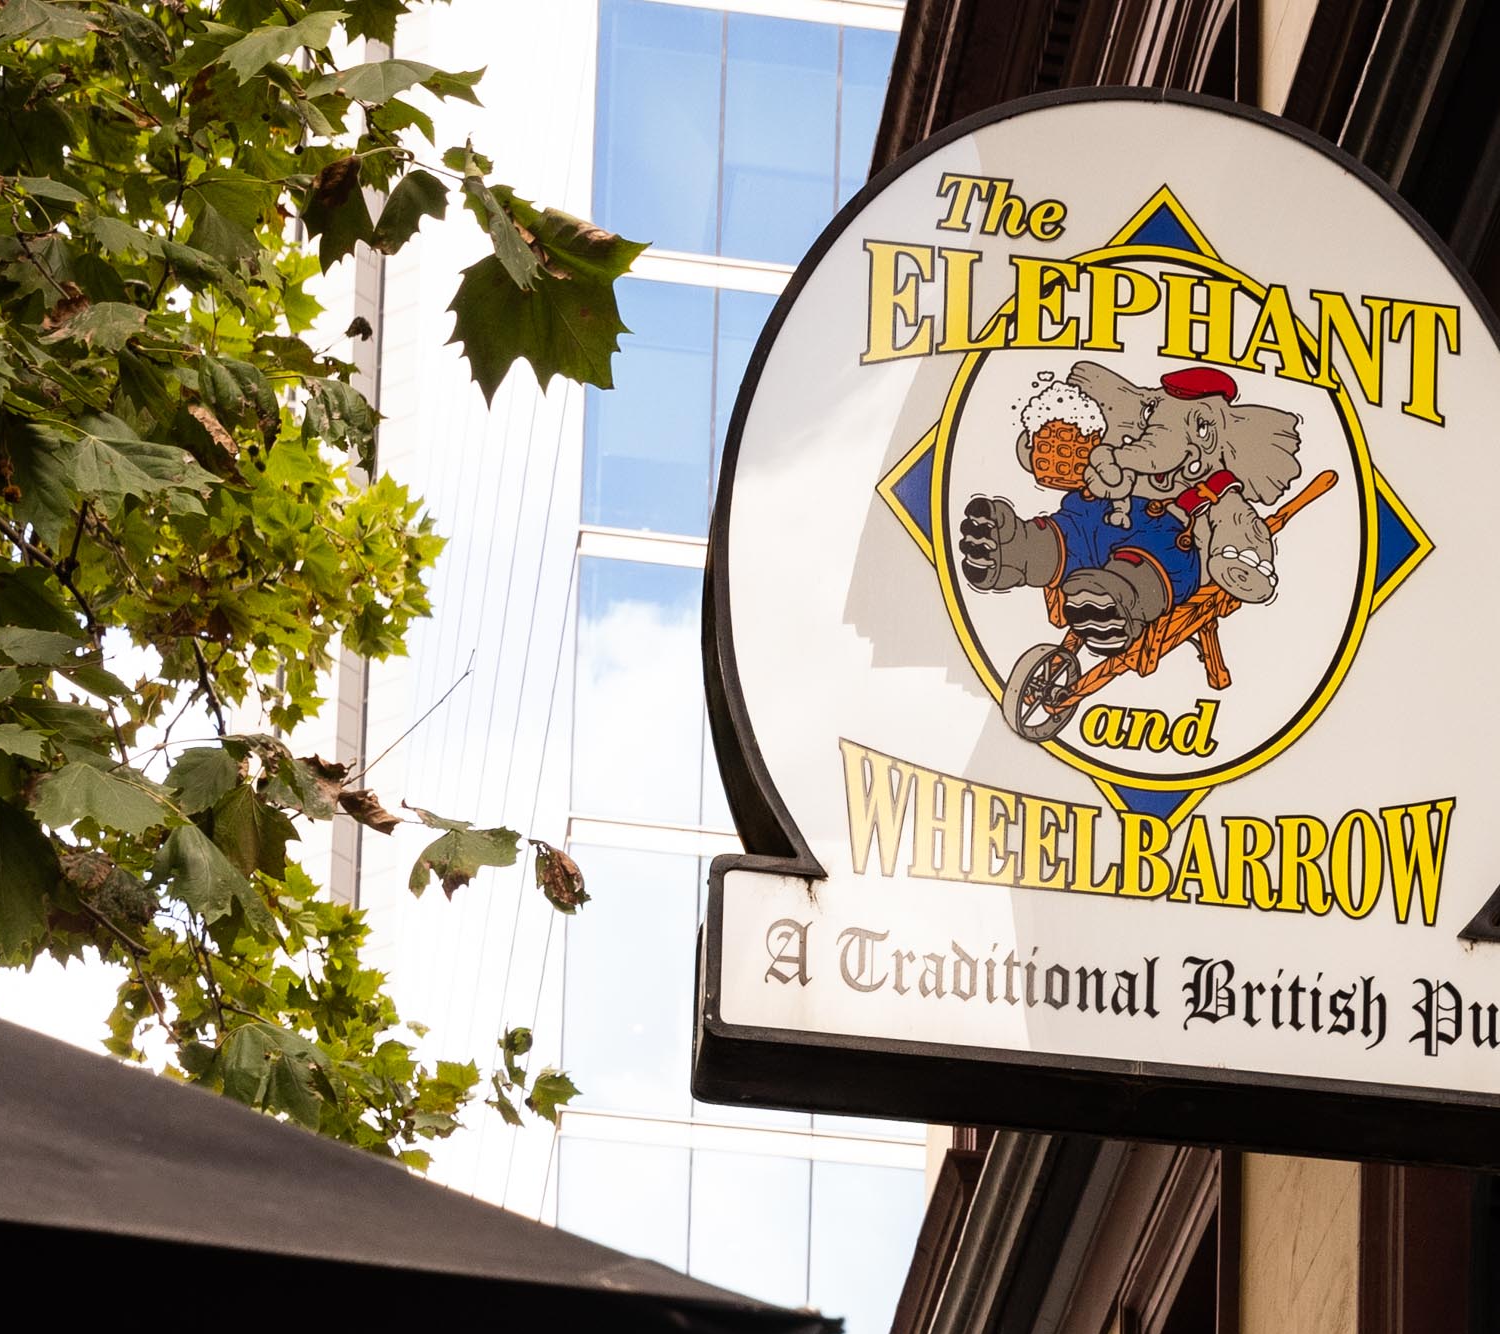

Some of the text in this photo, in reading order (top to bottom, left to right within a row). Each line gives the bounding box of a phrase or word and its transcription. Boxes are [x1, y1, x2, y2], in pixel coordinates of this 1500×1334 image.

[936, 173, 1068, 241] The
[860, 240, 1461, 428] ELEPHANT
[1078, 699, 1218, 758] and
[839, 739, 1456, 926] WHEELBARROW
[765, 919, 814, 989] A
[836, 926, 1161, 1021] Traditional
[1182, 956, 1387, 1049] British
